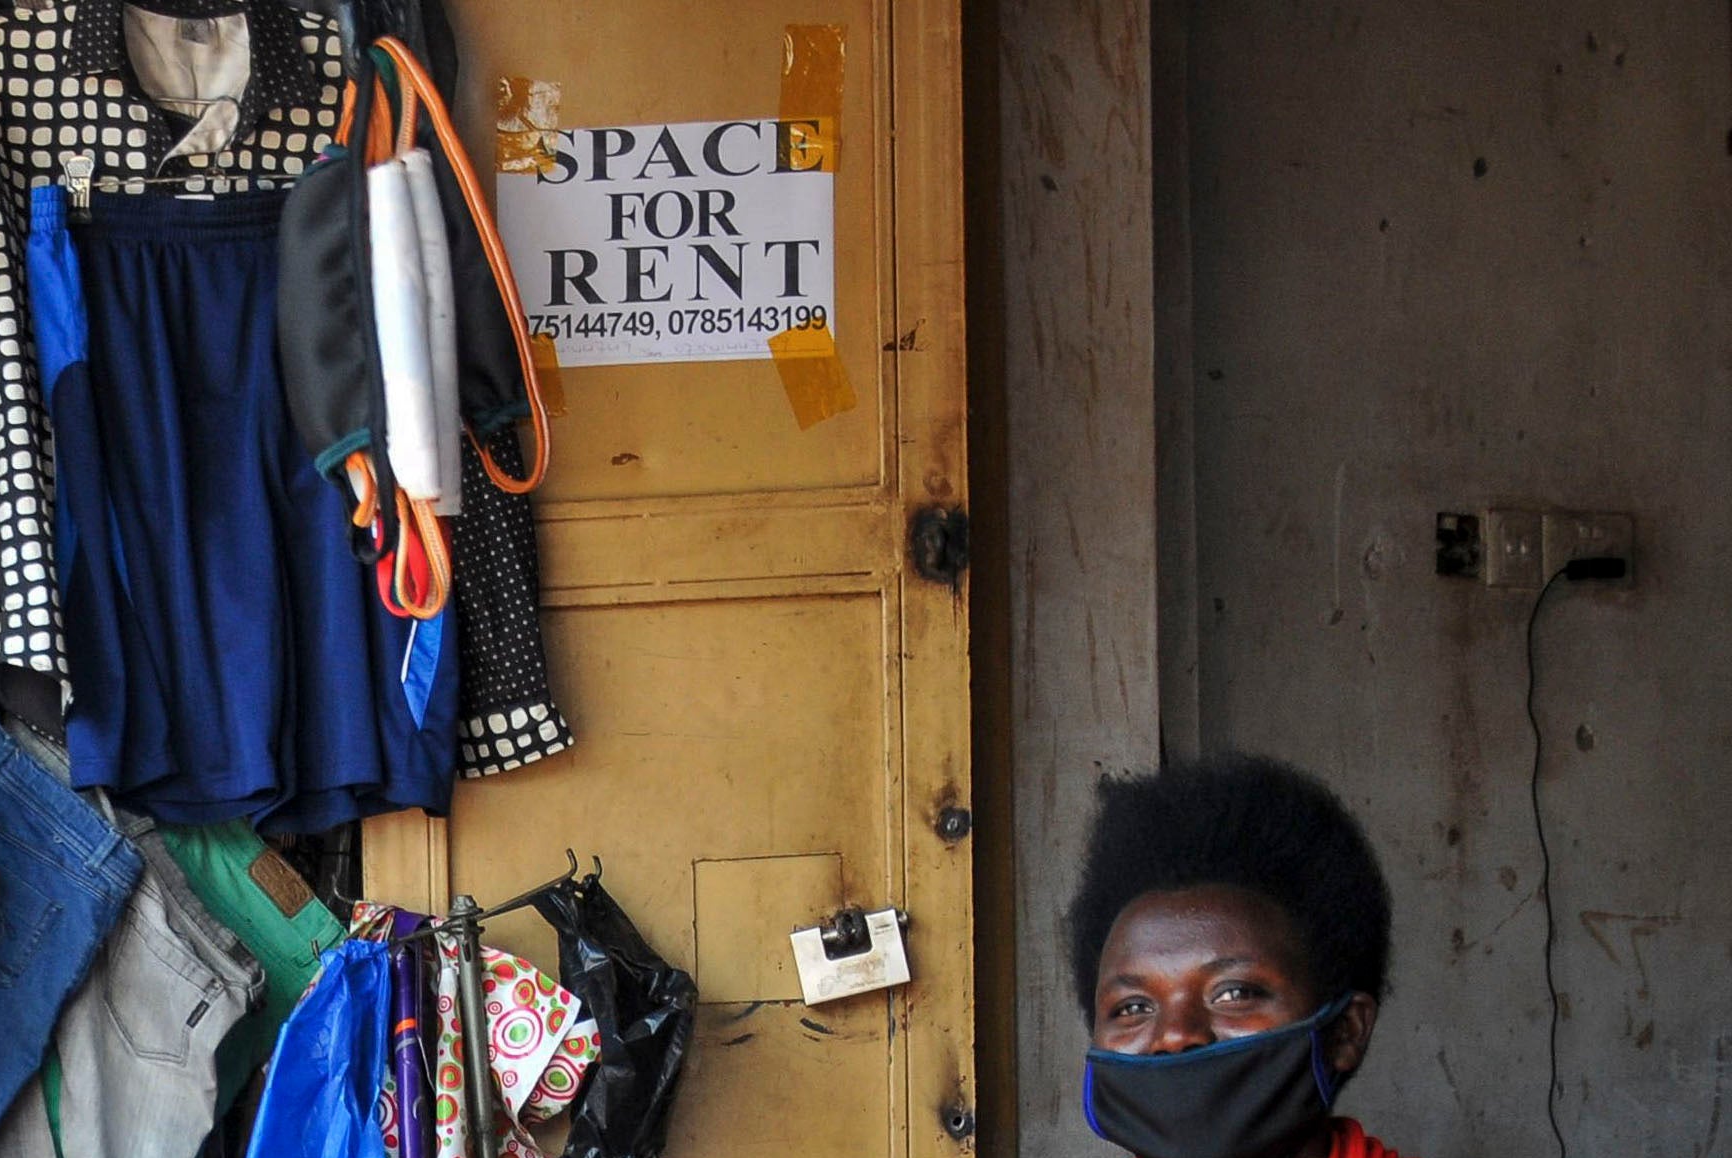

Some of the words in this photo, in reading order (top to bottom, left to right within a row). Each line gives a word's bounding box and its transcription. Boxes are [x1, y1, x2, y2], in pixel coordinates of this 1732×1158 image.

[536, 120, 825, 185] SPACE
[605, 189, 741, 242] FOR
[544, 240, 820, 307] RENT
[668, 304, 828, 336] 0785143199
